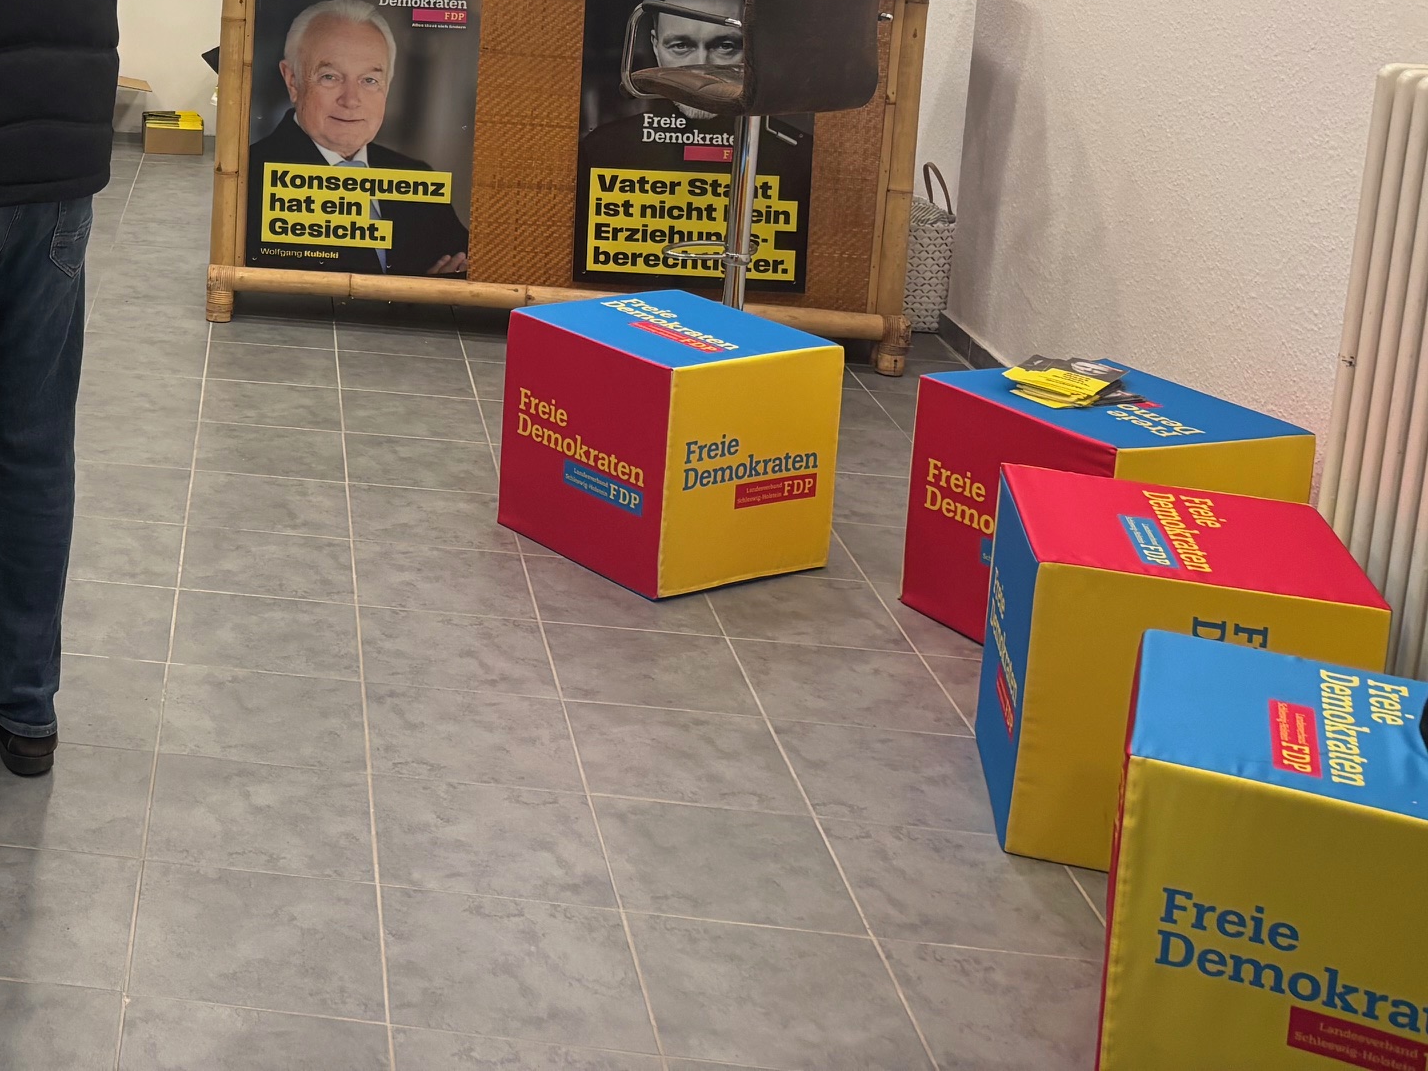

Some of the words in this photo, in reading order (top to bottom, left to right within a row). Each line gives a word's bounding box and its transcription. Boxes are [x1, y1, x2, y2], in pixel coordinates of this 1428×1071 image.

[444, 12, 465, 21] FDP
[643, 113, 686, 128] Freie
[270, 170, 445, 197] Konsequenz
[597, 174, 681, 195] Vater
[687, 178, 772, 200] Stat
[269, 193, 315, 214] hat
[320, 196, 362, 216] ein
[595, 197, 633, 217] ist
[639, 200, 717, 221] nicht
[268, 217, 386, 242] Gesicht.
[594, 223, 769, 246] Erziehuns-
[260, 247, 303, 258] Wolfgang
[304, 250, 339, 259] Kubicki
[593, 246, 789, 275] berechtier.
[620, 298, 678, 319] Freie
[600, 300, 740, 350] Demokraten
[681, 337, 719, 353] FDP
[518, 387, 568, 427] Freie
[1106, 408, 1183, 437] Freie
[517, 412, 645, 488] Demokraten
[684, 434, 740, 464] Freie
[682, 452, 818, 491] Demokraten
[926, 457, 986, 502] Freie
[609, 483, 640, 509] FDP
[783, 478, 814, 496] FDP
[1178, 494, 1227, 528] Freie
[1141, 490, 1212, 572] Demokraten
[1140, 543, 1171, 566] FDP
[1367, 678, 1415, 726] Freie
[1319, 669, 1371, 787] Demokraten
[1281, 740, 1312, 773] FDP
[1159, 886, 1300, 952] Freie
[1154, 929, 1428, 1035] Demokra
[1319, 1022, 1419, 1059] Landesverband
